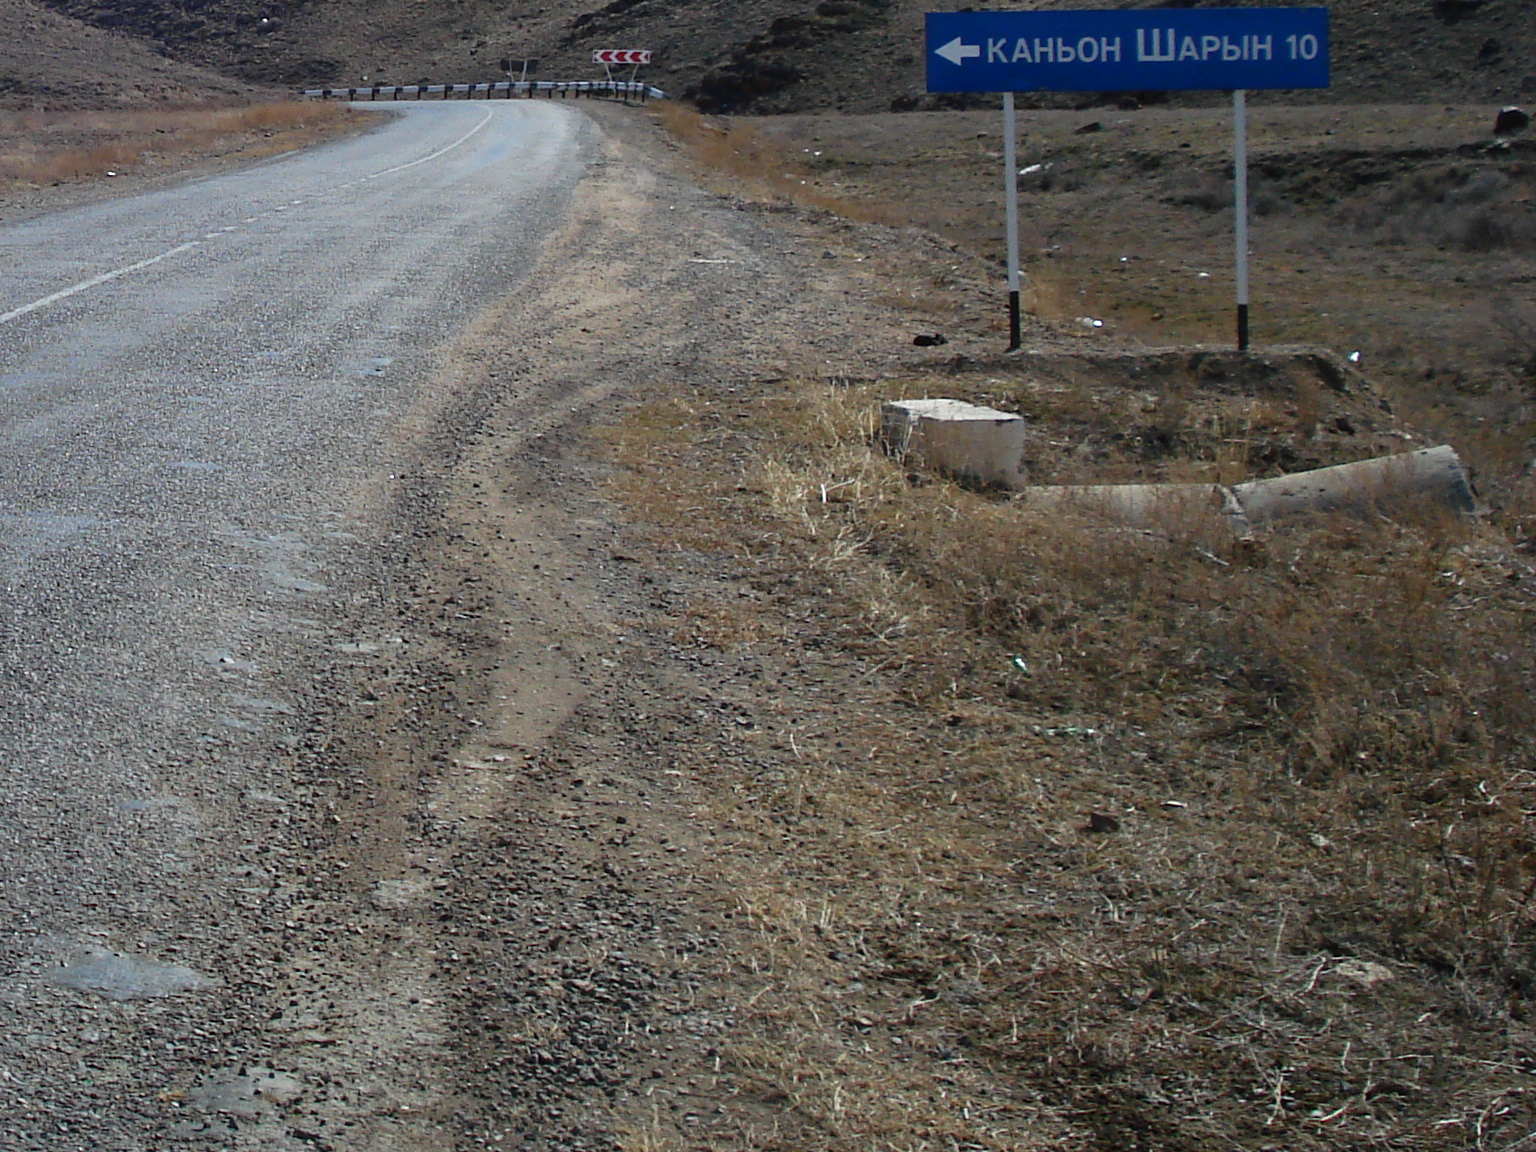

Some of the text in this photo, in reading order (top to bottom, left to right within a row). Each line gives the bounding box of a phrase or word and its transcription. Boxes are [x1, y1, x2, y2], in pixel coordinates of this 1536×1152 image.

[987, 28, 1318, 63] КАНЬОН ШАРЫН 10
